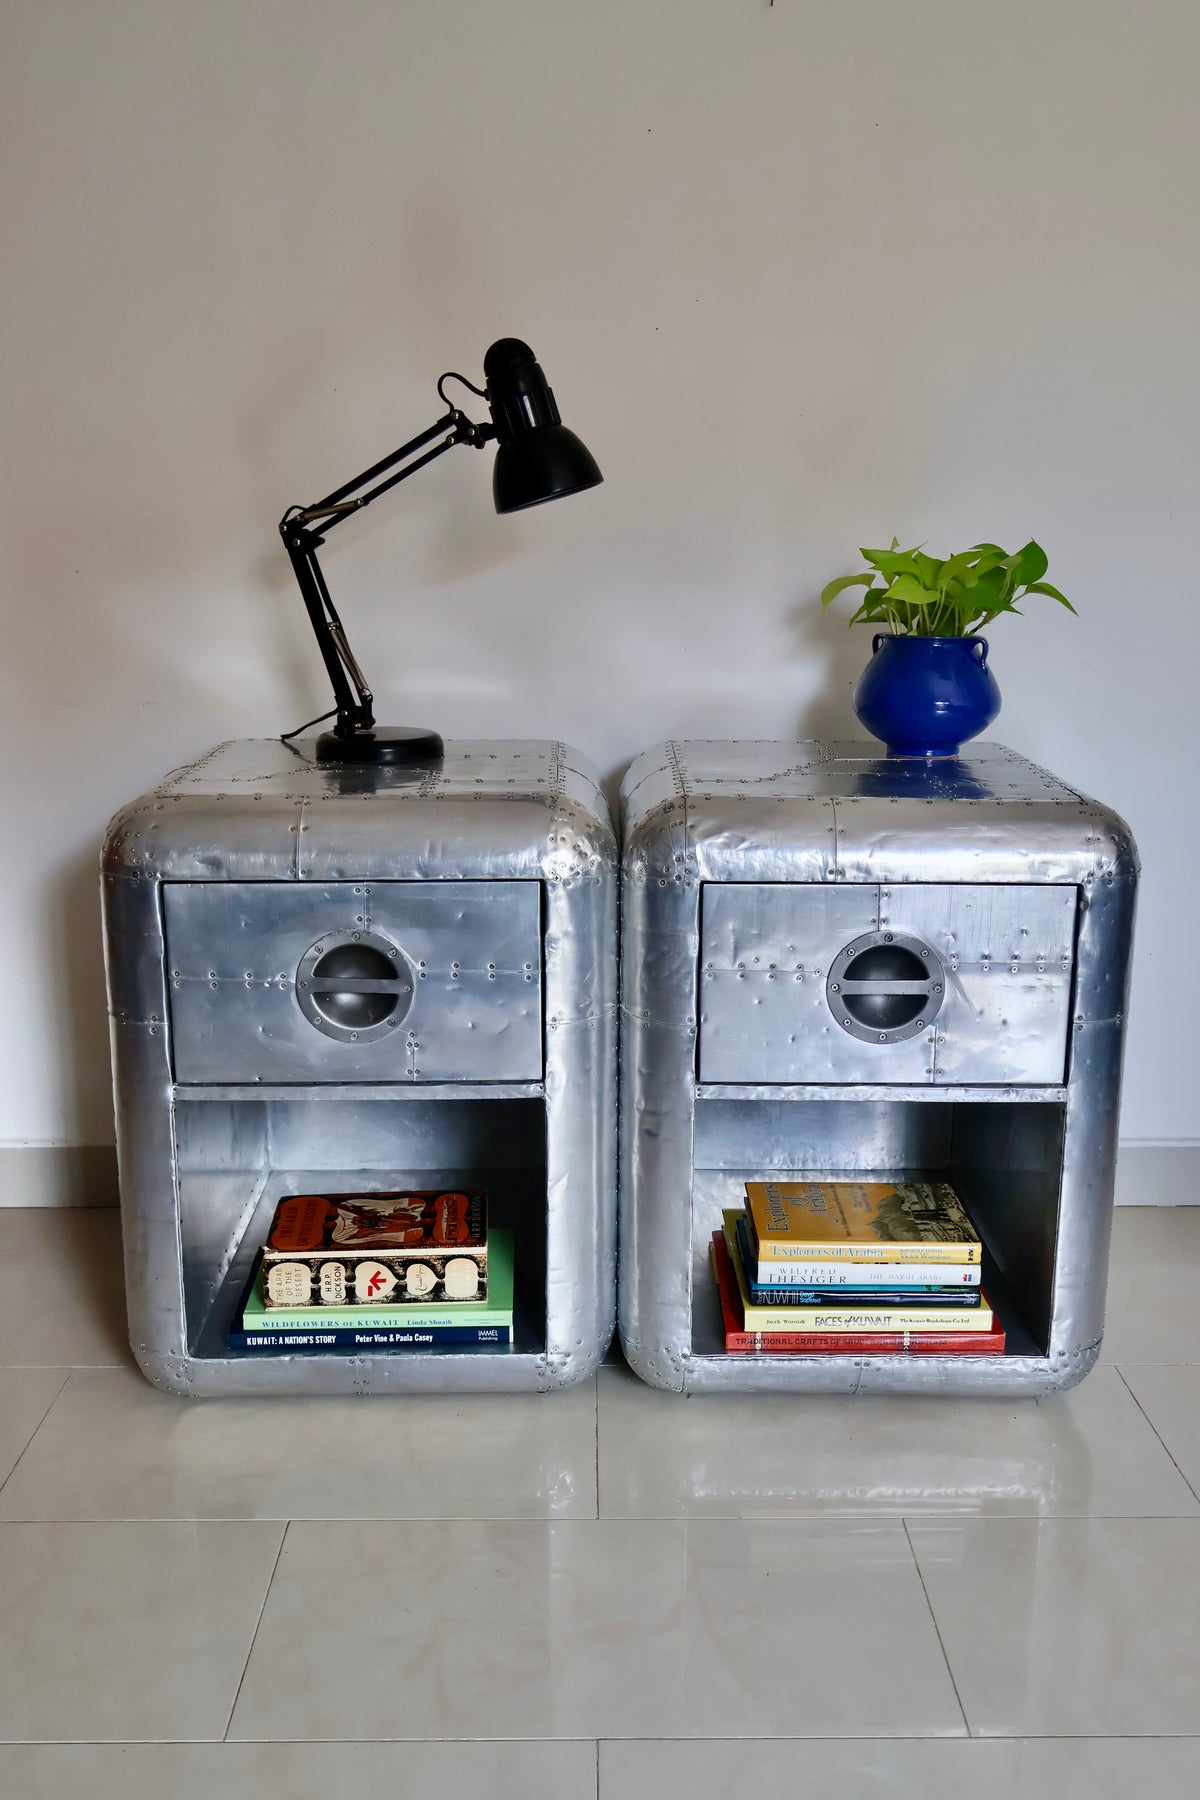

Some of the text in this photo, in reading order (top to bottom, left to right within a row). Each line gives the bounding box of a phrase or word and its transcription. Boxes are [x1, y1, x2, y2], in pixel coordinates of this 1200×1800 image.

[782, 1196, 809, 1207] of
[471, 1196, 481, 1221] DICKSON
[764, 1183, 789, 1232] Explorers
[773, 1244, 884, 1258] Explorers of Arabia
[779, 1267, 836, 1275] WILFRED
[275, 1267, 284, 1301] THE ARAB
[294, 1268, 303, 1297] DESERT
[334, 1265, 343, 1299] DICKSON
[768, 1273, 847, 1284] THESIGER
[286, 1286, 293, 1296] OF
[357, 1319, 400, 1327] KUWAIT
[815, 1315, 892, 1328] FACES of KUWAIT
[355, 1332, 433, 1343] Peter Vine & Paula Casey
[478, 1329, 499, 1337] IMMEL
[246, 1335, 337, 1346] KUWAIT: A NATION'S STORY
[736, 1338, 794, 1346] TRADITIONAL
